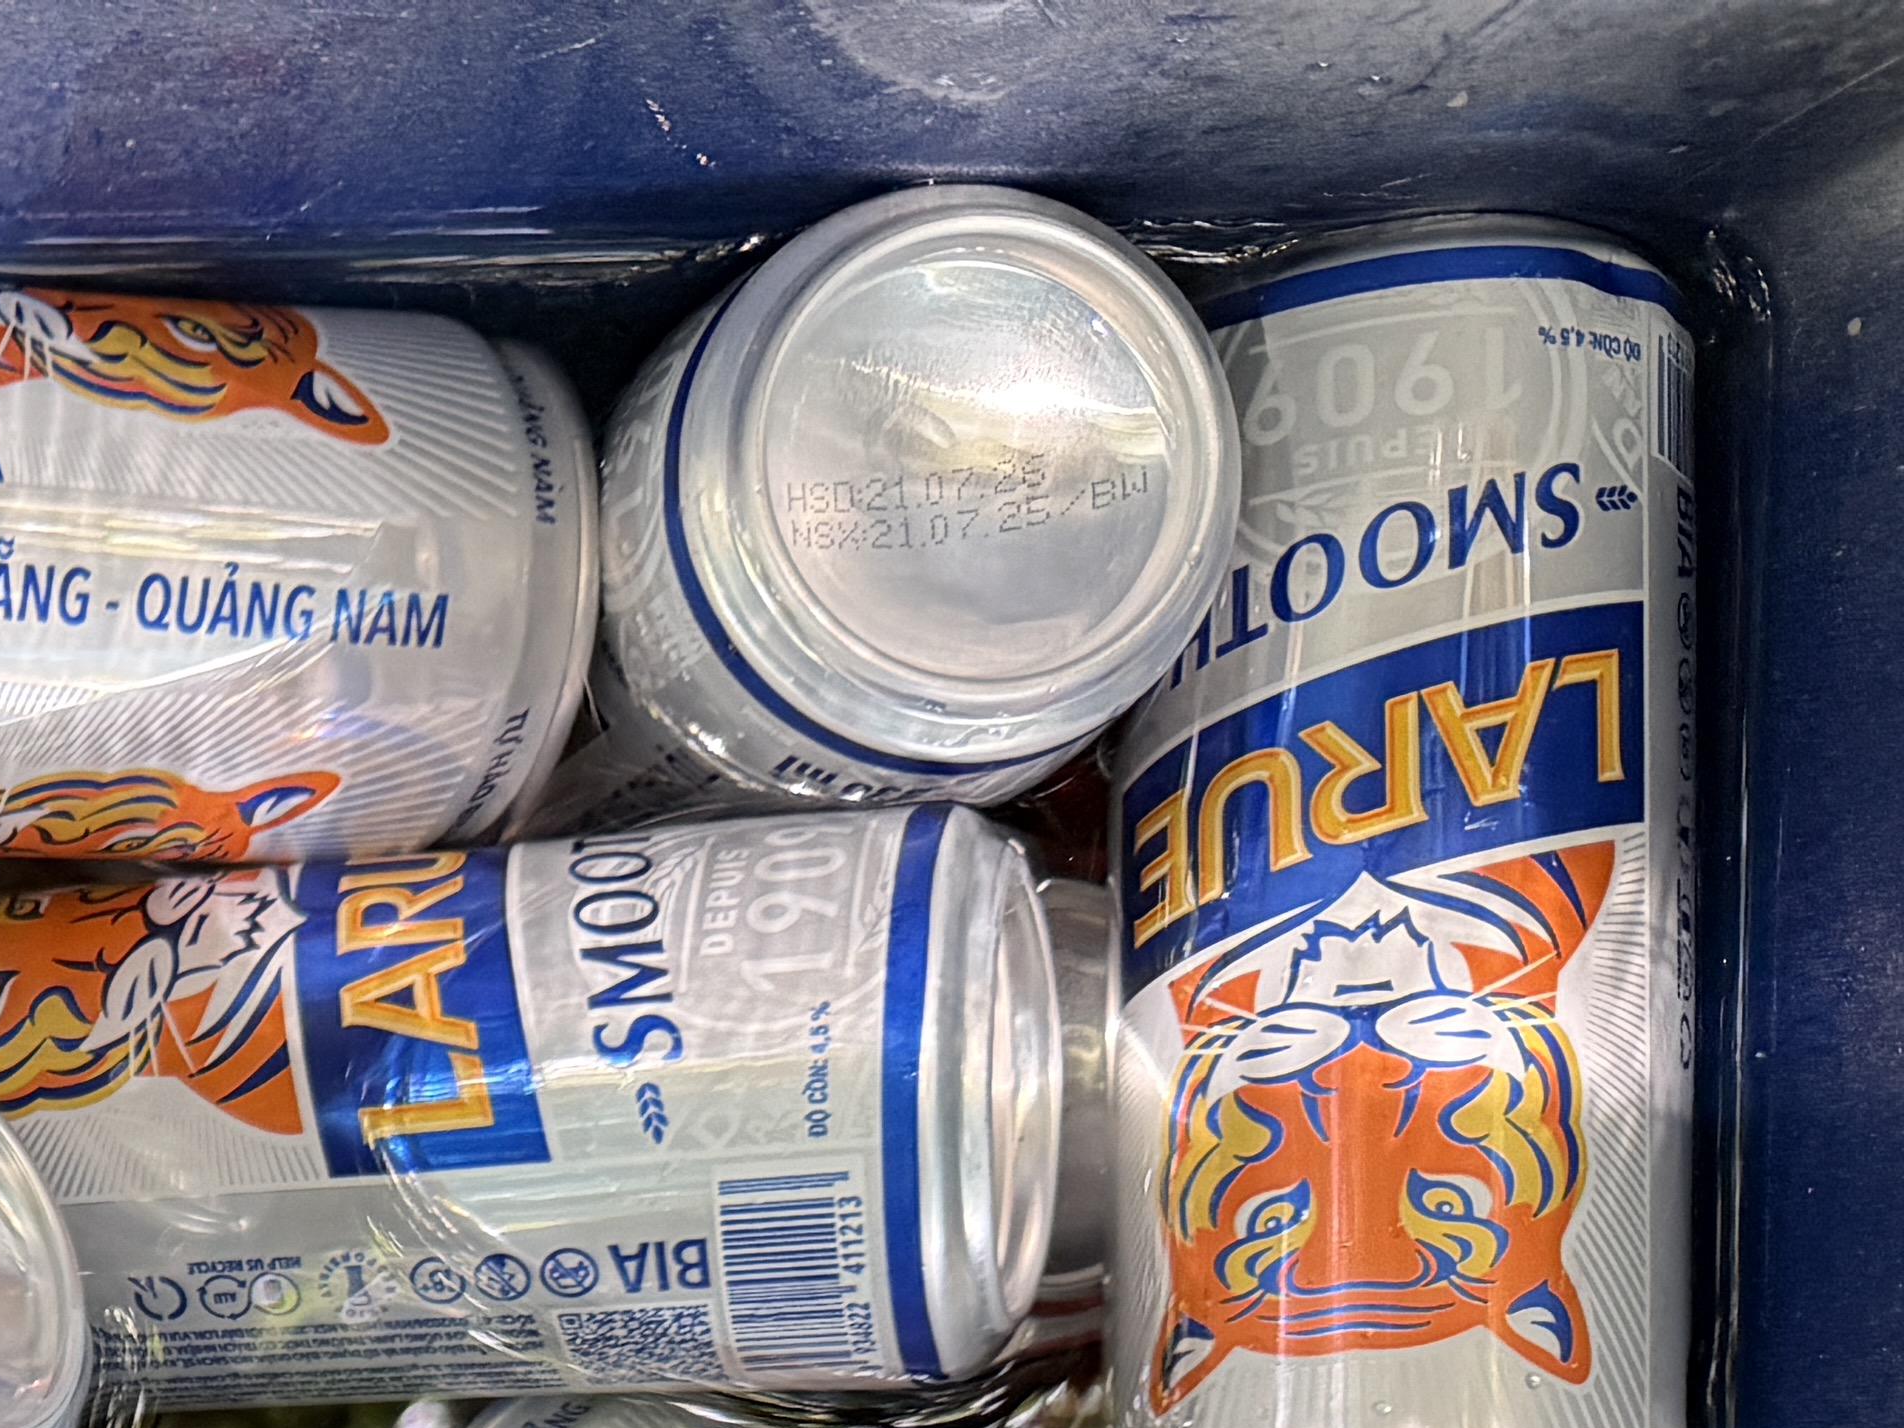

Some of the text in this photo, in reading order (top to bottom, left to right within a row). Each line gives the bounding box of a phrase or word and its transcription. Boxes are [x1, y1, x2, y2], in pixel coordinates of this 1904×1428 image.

[1537, 325, 1556, 343] %
[1558, 325, 1584, 345] 4,5
[1242, 323, 1523, 448] 1909
[135, 560, 312, 643] QUẢNG
[329, 593, 450, 648] NAM
[1133, 648, 1625, 950] LARUE
[699, 846, 751, 958] DEPUIS
[334, 851, 495, 1148] LARU
[810, 1000, 831, 1018] %
[810, 1021, 831, 1055] 4,5
[803, 1058, 831, 1104] CỒN:
[607, 1238, 711, 1294] BIA
[838, 1194, 863, 1275] 411213
